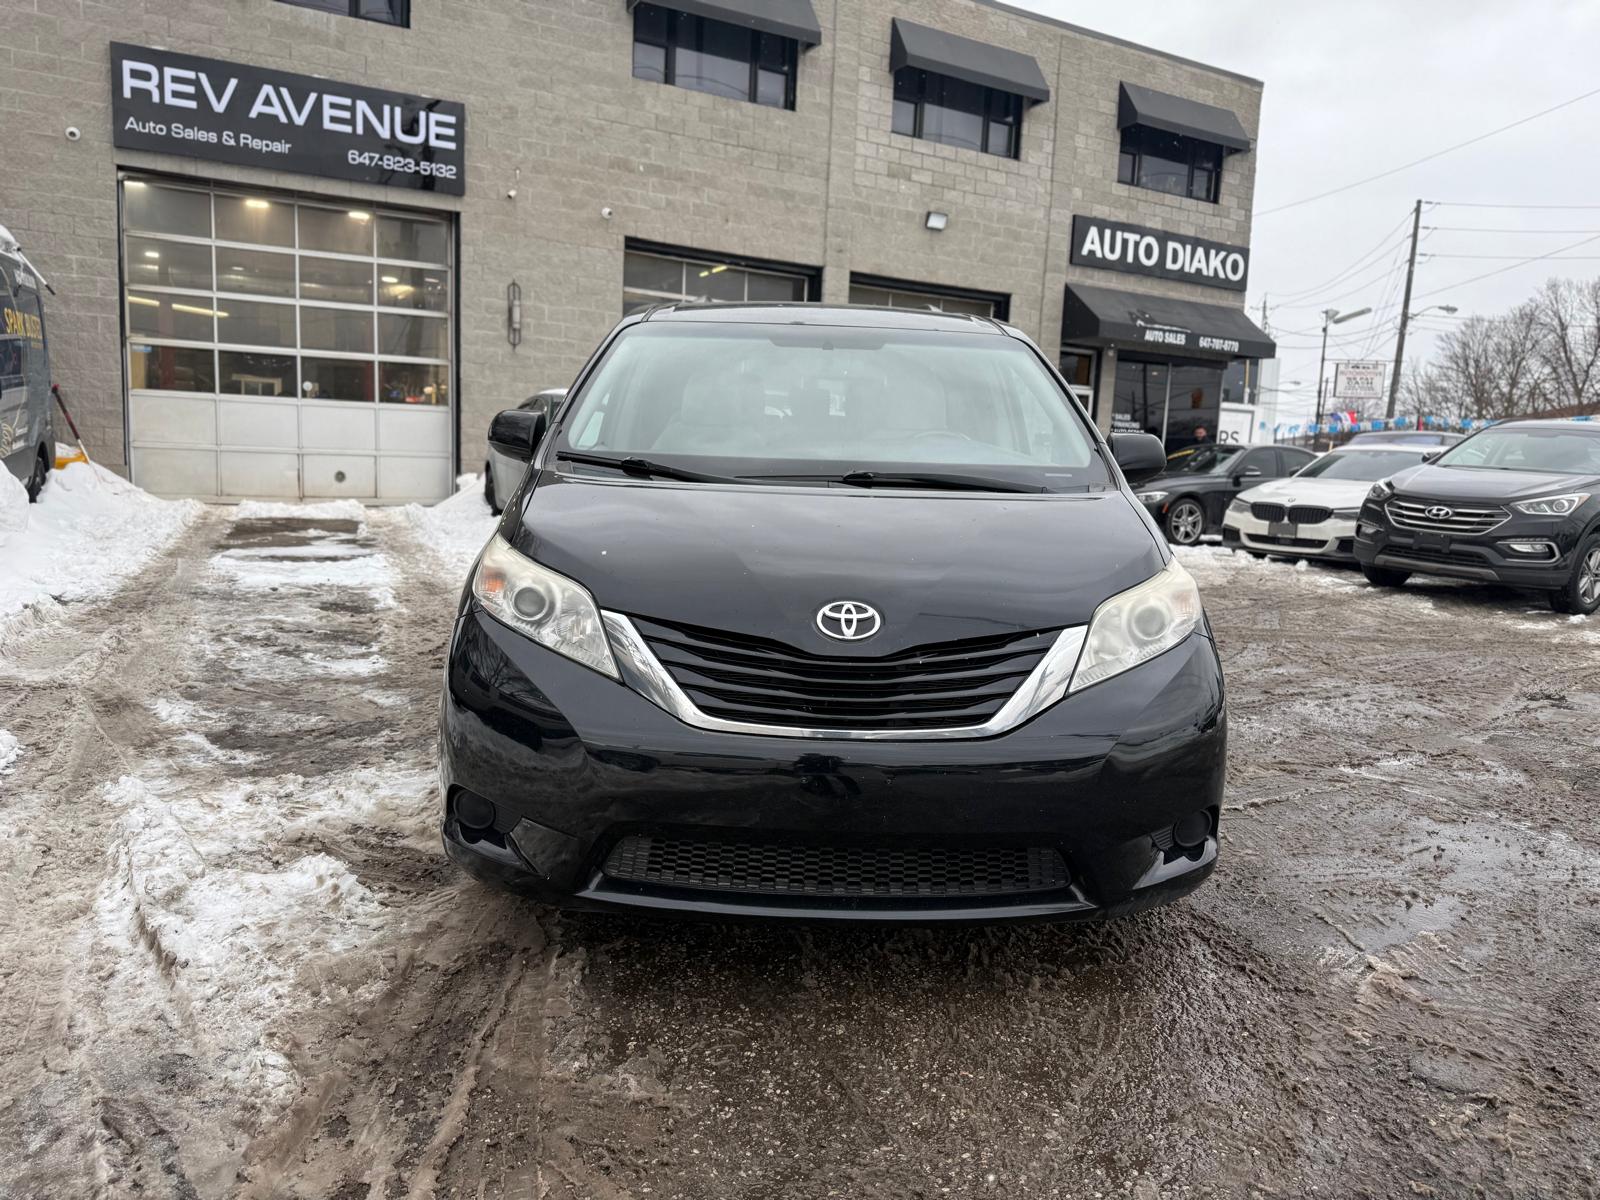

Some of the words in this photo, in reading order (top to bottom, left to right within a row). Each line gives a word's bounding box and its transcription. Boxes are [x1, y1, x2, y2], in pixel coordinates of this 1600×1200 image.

[122, 59, 239, 114] REV
[248, 83, 457, 150] AVENUE
[124, 116, 167, 136] Auto
[171, 123, 218, 143] Sales
[222, 131, 236, 146] &
[240, 133, 292, 154] Repair
[347, 150, 457, 179] 647-823-5132
[1081, 226, 1160, 267] AUTO
[1165, 241, 1245, 281] DIAKO
[1144, 329, 1163, 342] AUTO
[1164, 331, 1186, 345] SALES
